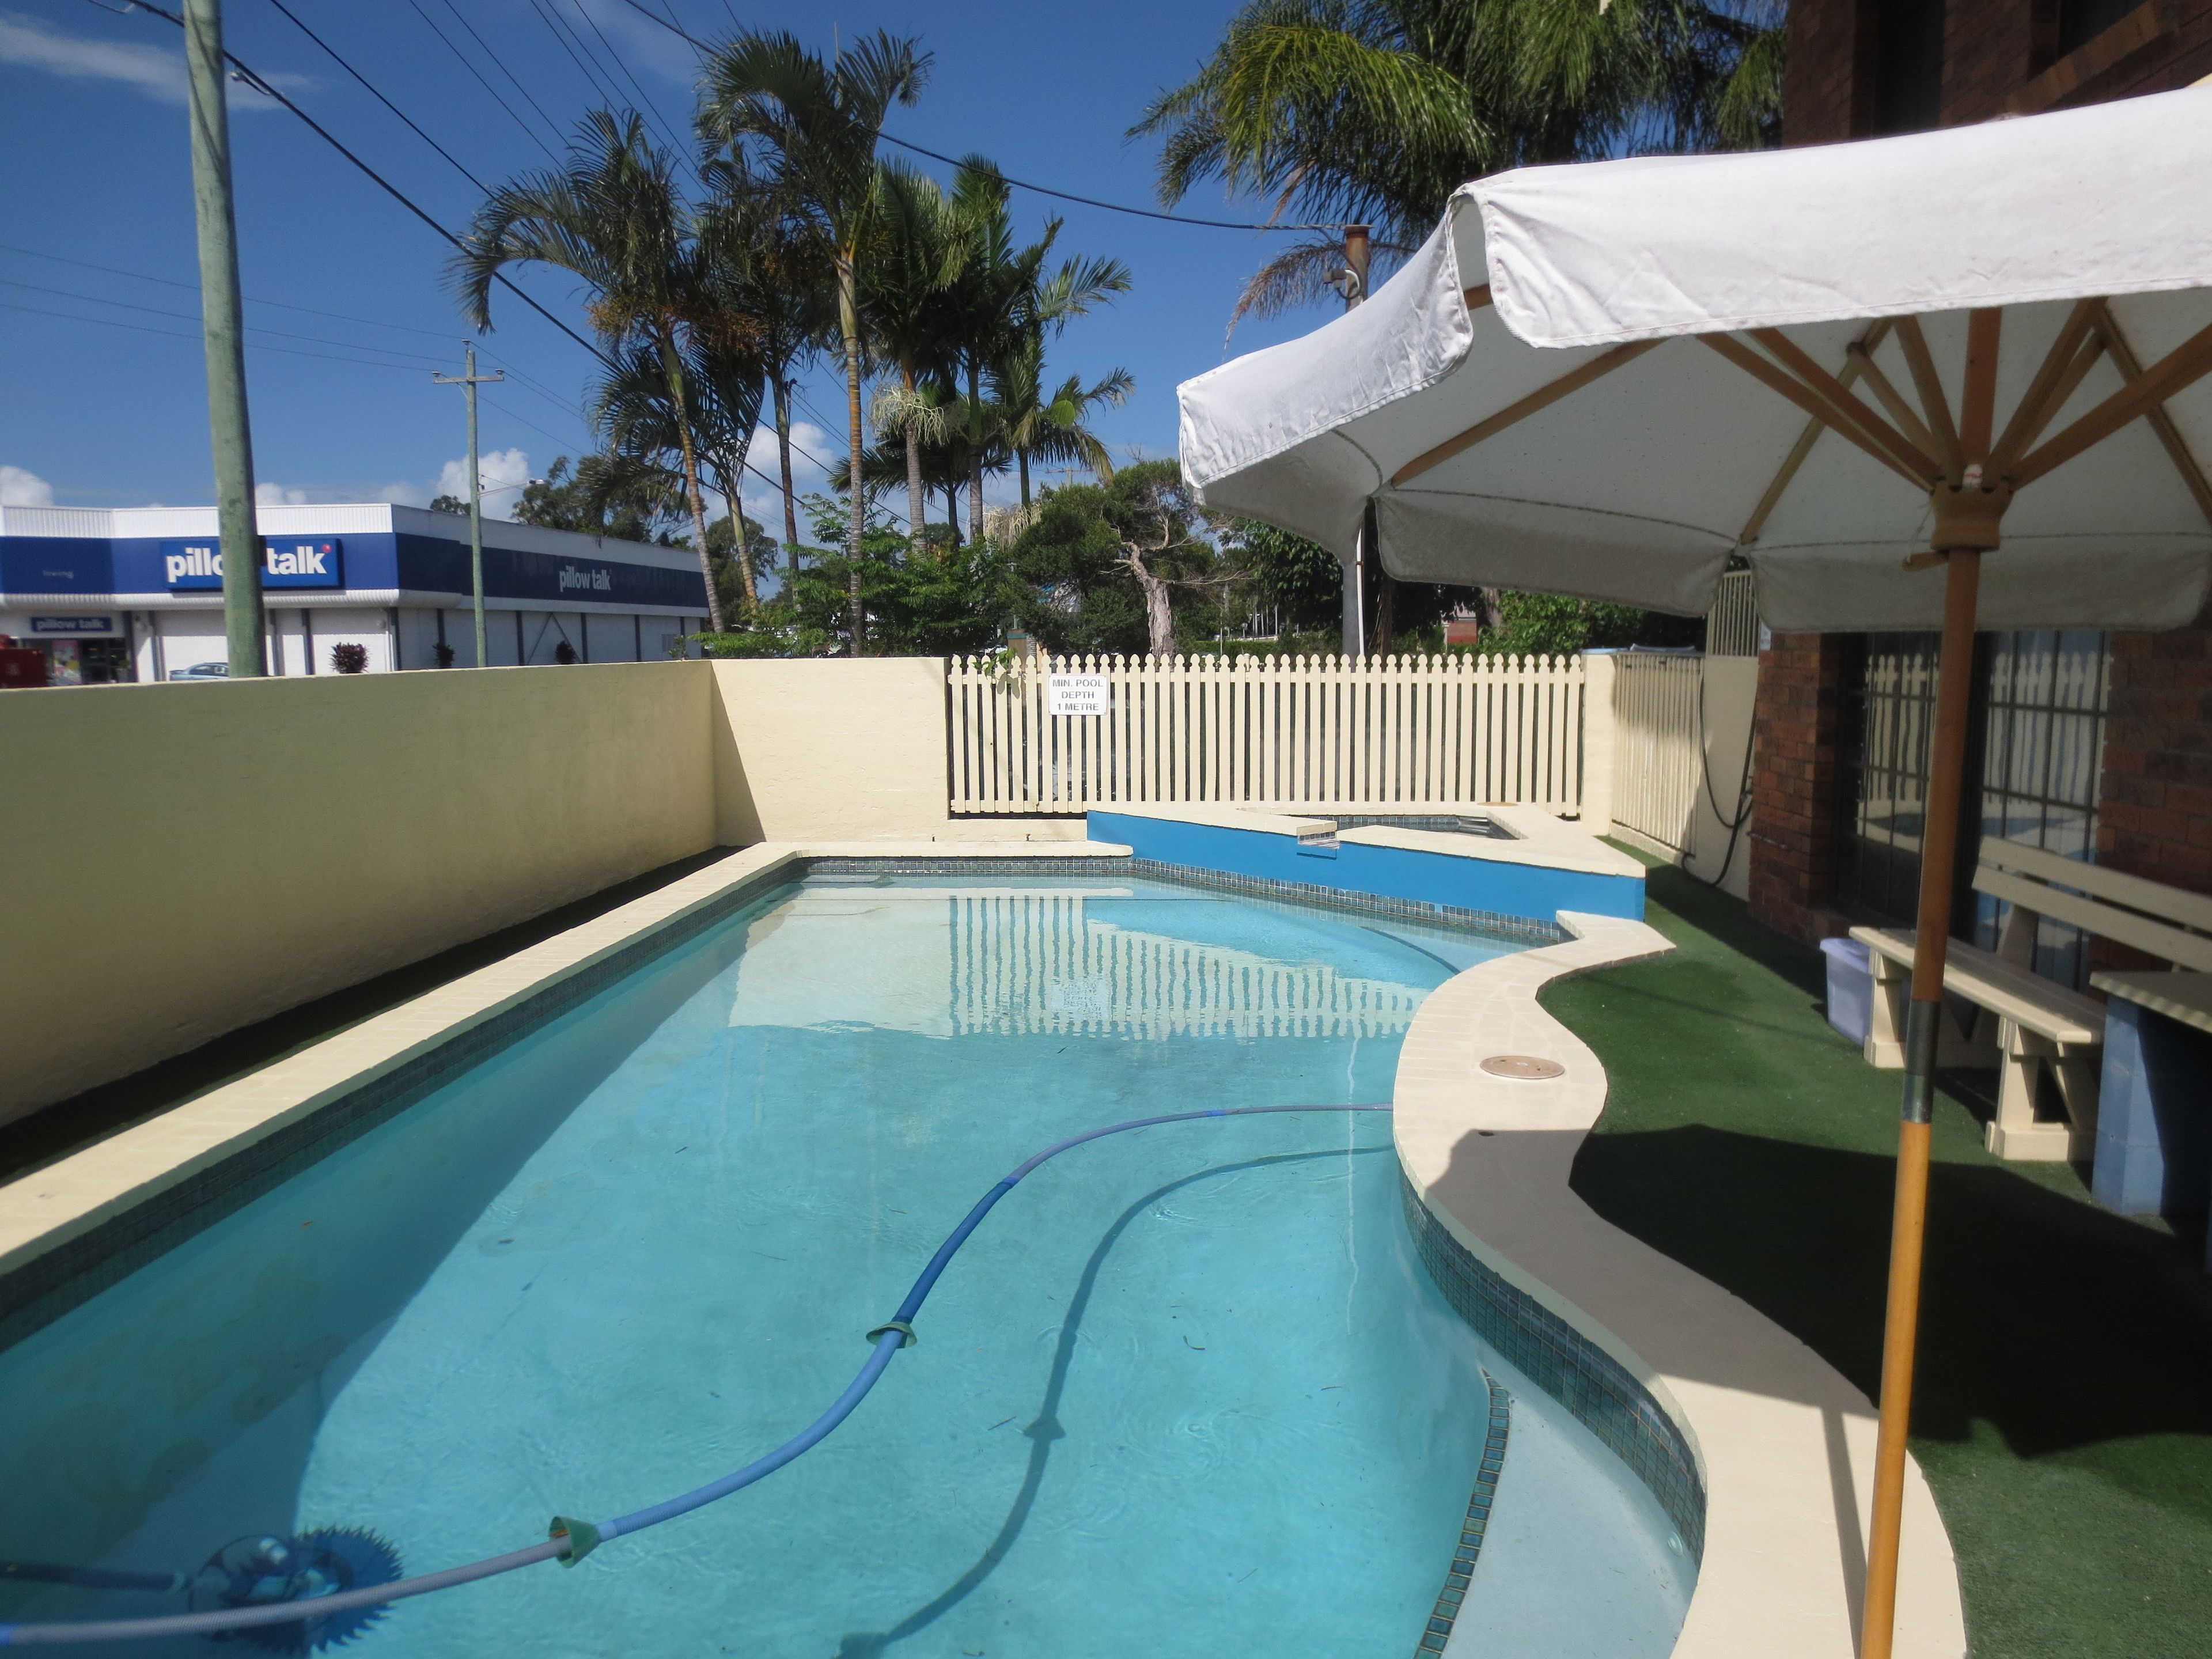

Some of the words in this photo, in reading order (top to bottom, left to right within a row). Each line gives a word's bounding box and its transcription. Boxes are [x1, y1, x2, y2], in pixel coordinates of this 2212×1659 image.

[266, 546, 327, 575] talk
[559, 565, 590, 593] pillow
[592, 569, 611, 590] talk
[1052, 679, 1073, 687] MIN.
[1075, 679, 1104, 687] POOL
[1061, 691, 1094, 699] DEPTH
[1057, 703, 1061, 711] 1
[1065, 703, 1100, 711] METRE
